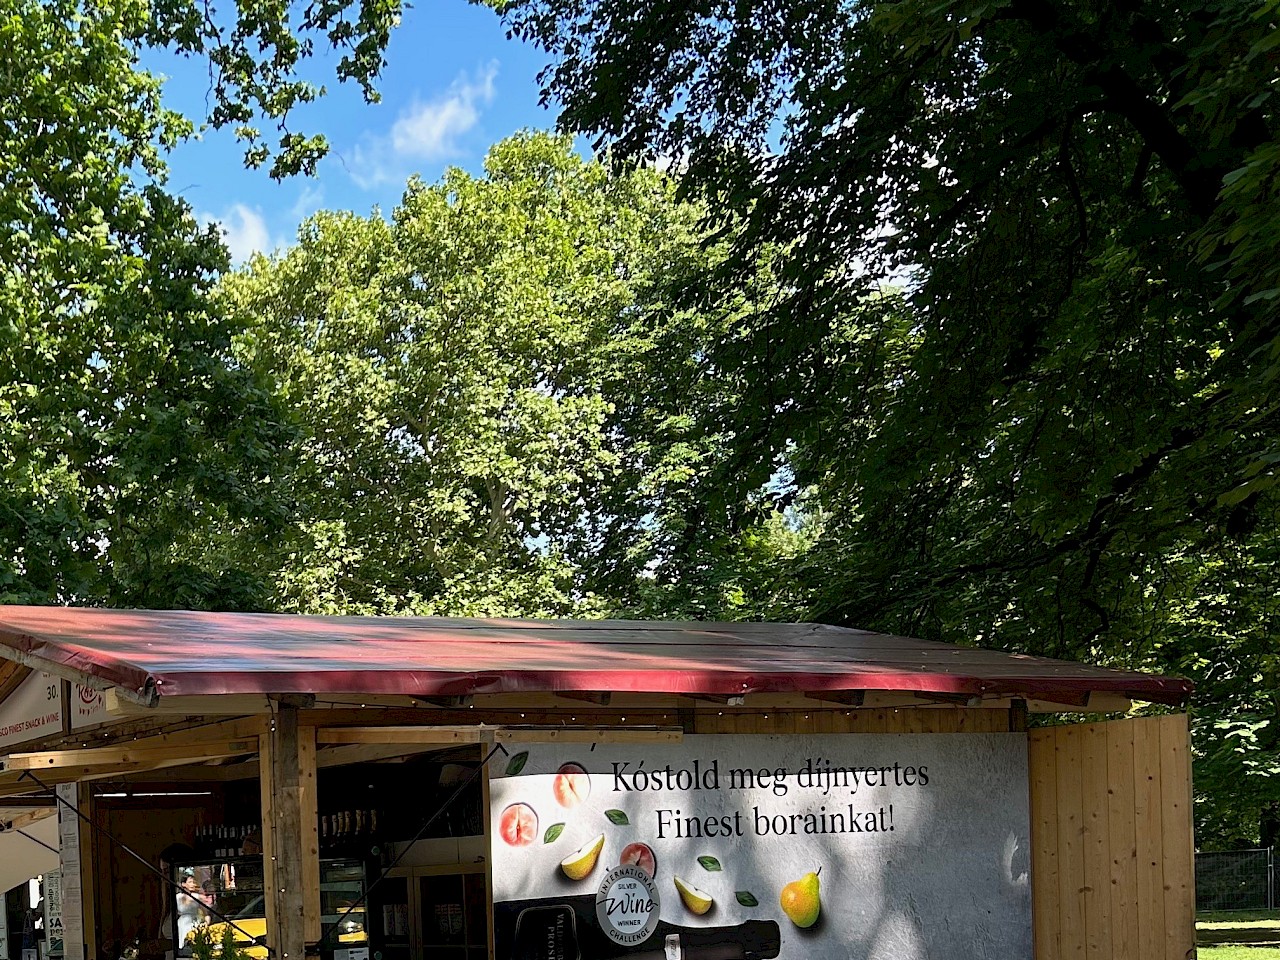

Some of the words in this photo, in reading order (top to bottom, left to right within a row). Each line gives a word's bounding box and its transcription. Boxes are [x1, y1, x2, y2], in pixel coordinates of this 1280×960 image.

[9, 722, 25, 735] FINEST
[25, 718, 41, 730] SNACK
[46, 712, 60, 724] WINE
[612, 759, 721, 792] Kóstold
[729, 766, 789, 796] meg
[796, 757, 930, 795] díjnyertes
[656, 808, 745, 838] Finest
[753, 804, 895, 836] borainkat!
[600, 867, 656, 895] INTERNATIONAL
[597, 893, 658, 916] Wine
[617, 919, 642, 927] WINNER
[609, 928, 651, 942] CHALLENGE
